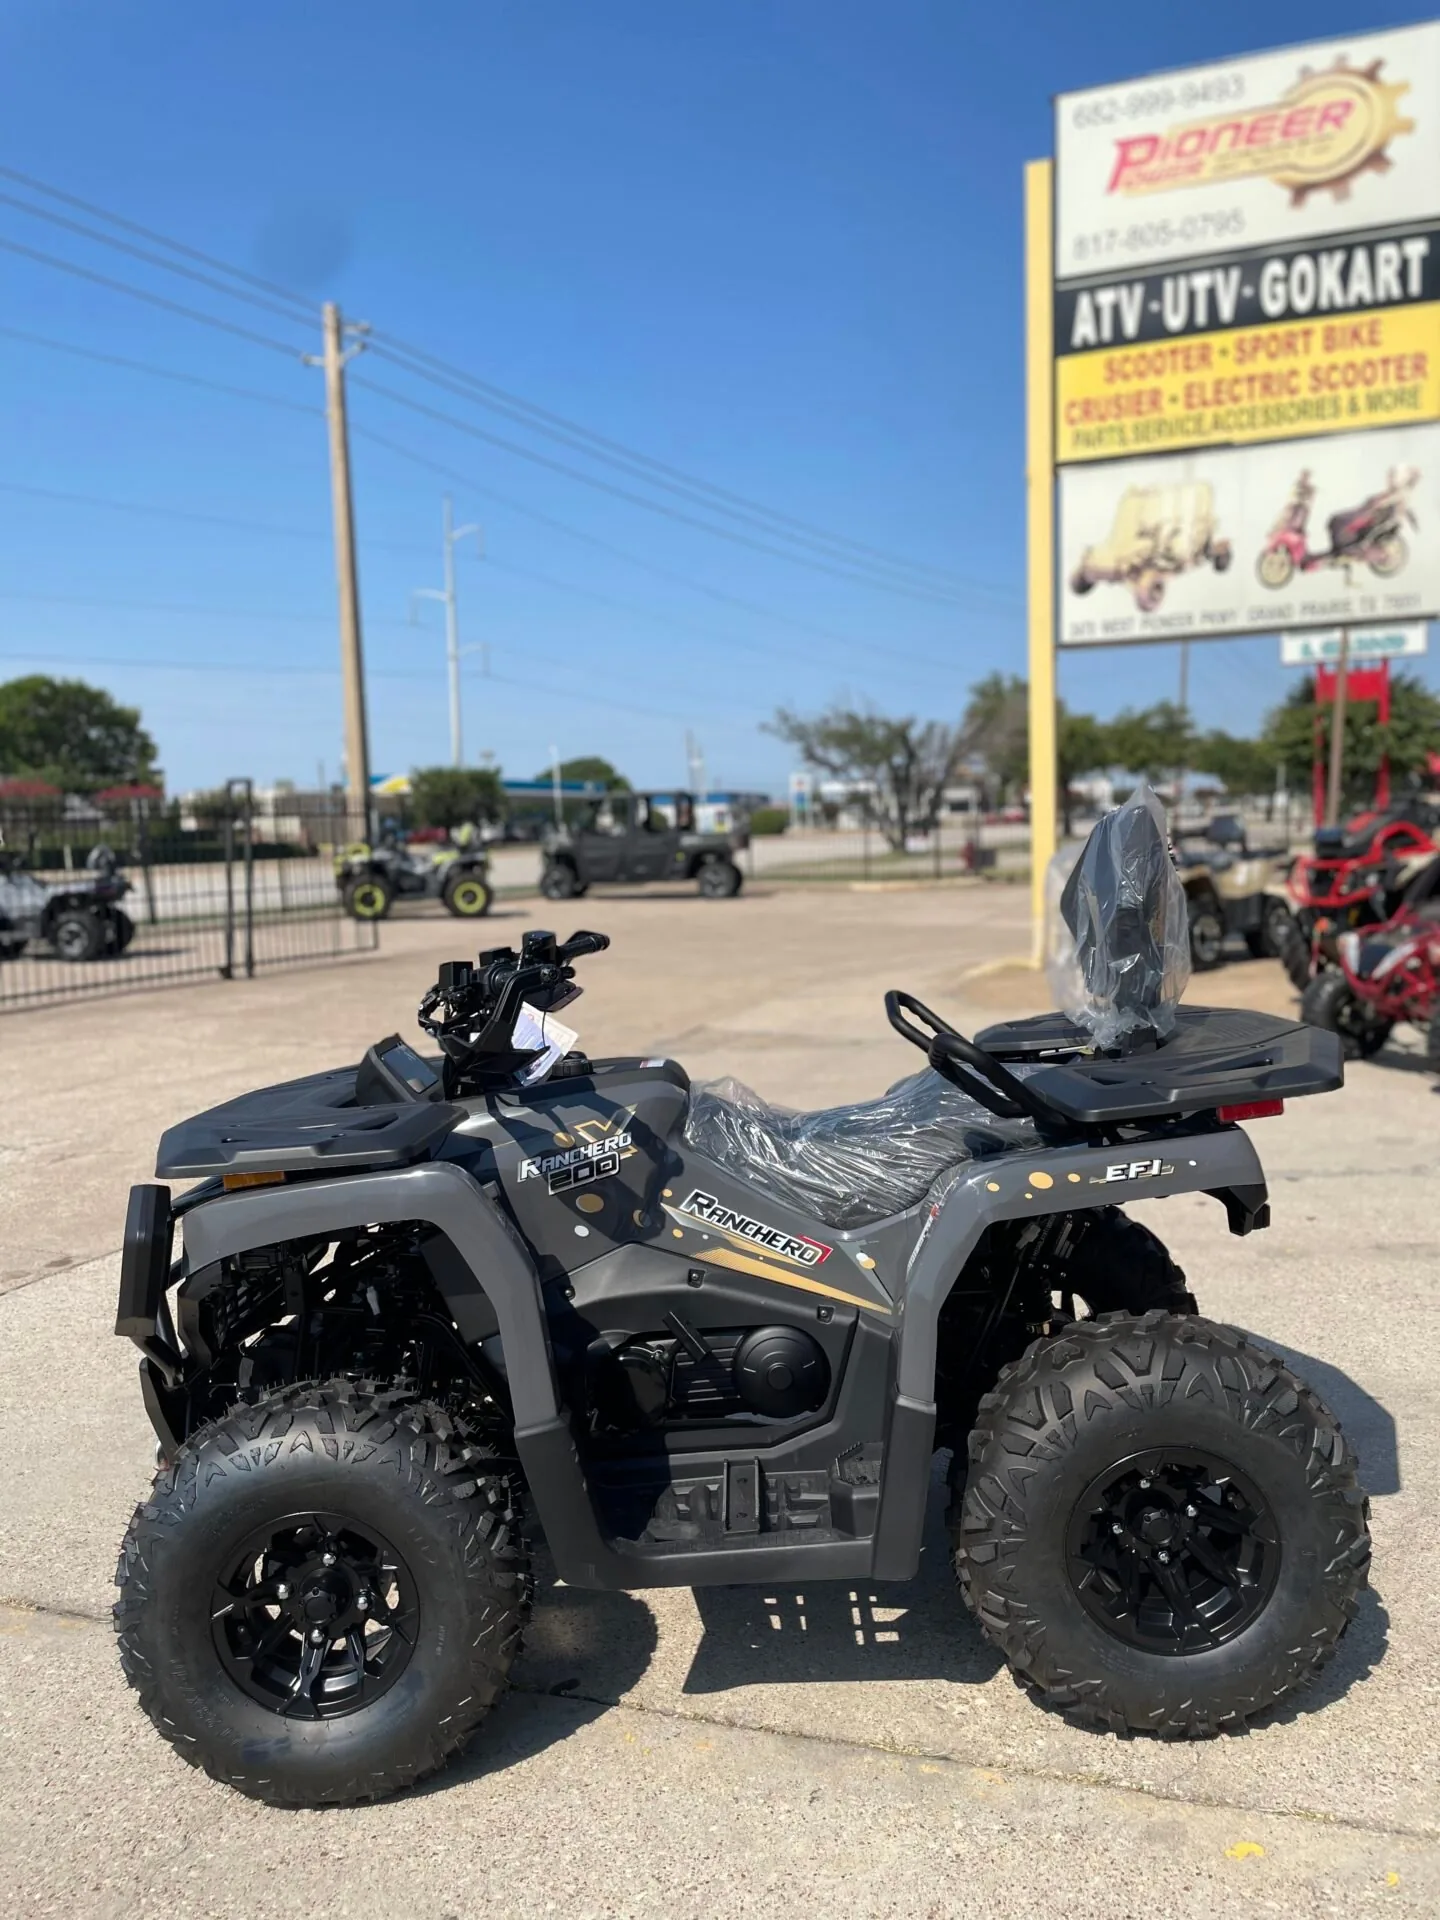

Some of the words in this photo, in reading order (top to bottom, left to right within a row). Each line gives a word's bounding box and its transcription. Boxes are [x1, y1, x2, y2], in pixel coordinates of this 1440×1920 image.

[1106, 99, 1355, 194] PIONEER
[1071, 282, 1144, 348] ATV
[1162, 265, 1242, 332] UTV
[1260, 237, 1430, 317] GOKART
[1103, 342, 1213, 384] SCOOTER
[1233, 327, 1316, 366] SPORT
[1323, 318, 1382, 351] BIKE
[1065, 387, 1163, 426] CRUSIER
[1184, 369, 1301, 410] ELECTRIC
[1308, 352, 1429, 394] SCOOTER
[1365, 385, 1422, 411] MORE
[518, 1132, 632, 1181] RANCHERO
[549, 1152, 619, 1194] 200
[1106, 1159, 1163, 1183] EFI
[680, 1190, 824, 1266] RANCHERO
